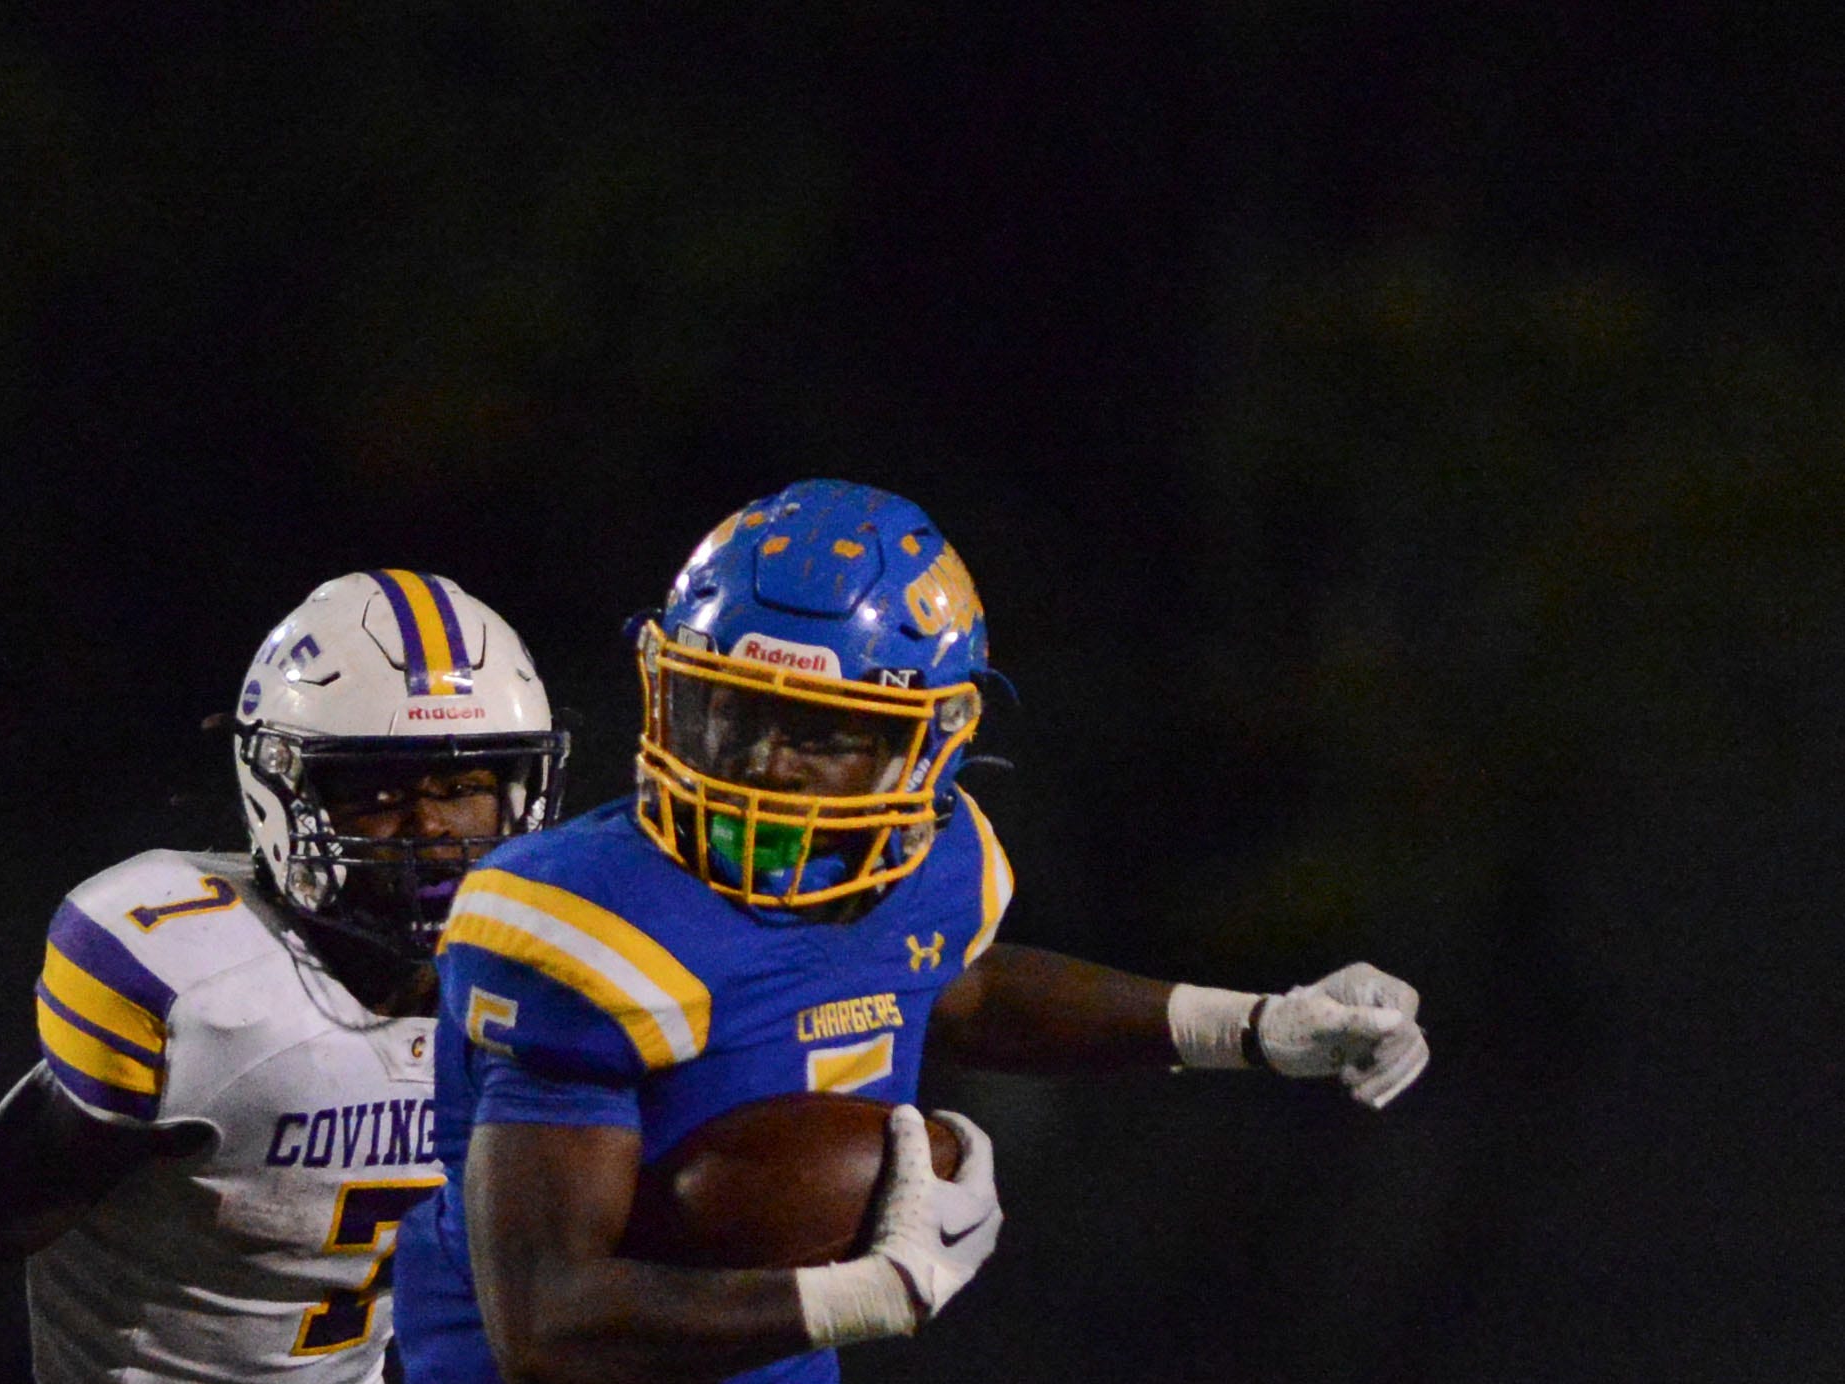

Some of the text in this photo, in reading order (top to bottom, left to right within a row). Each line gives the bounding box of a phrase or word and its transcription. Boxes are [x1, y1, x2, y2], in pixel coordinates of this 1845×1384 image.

[124, 873, 242, 935] 7
[797, 992, 904, 1042] CHARGERS
[289, 1175, 448, 1357] 7
